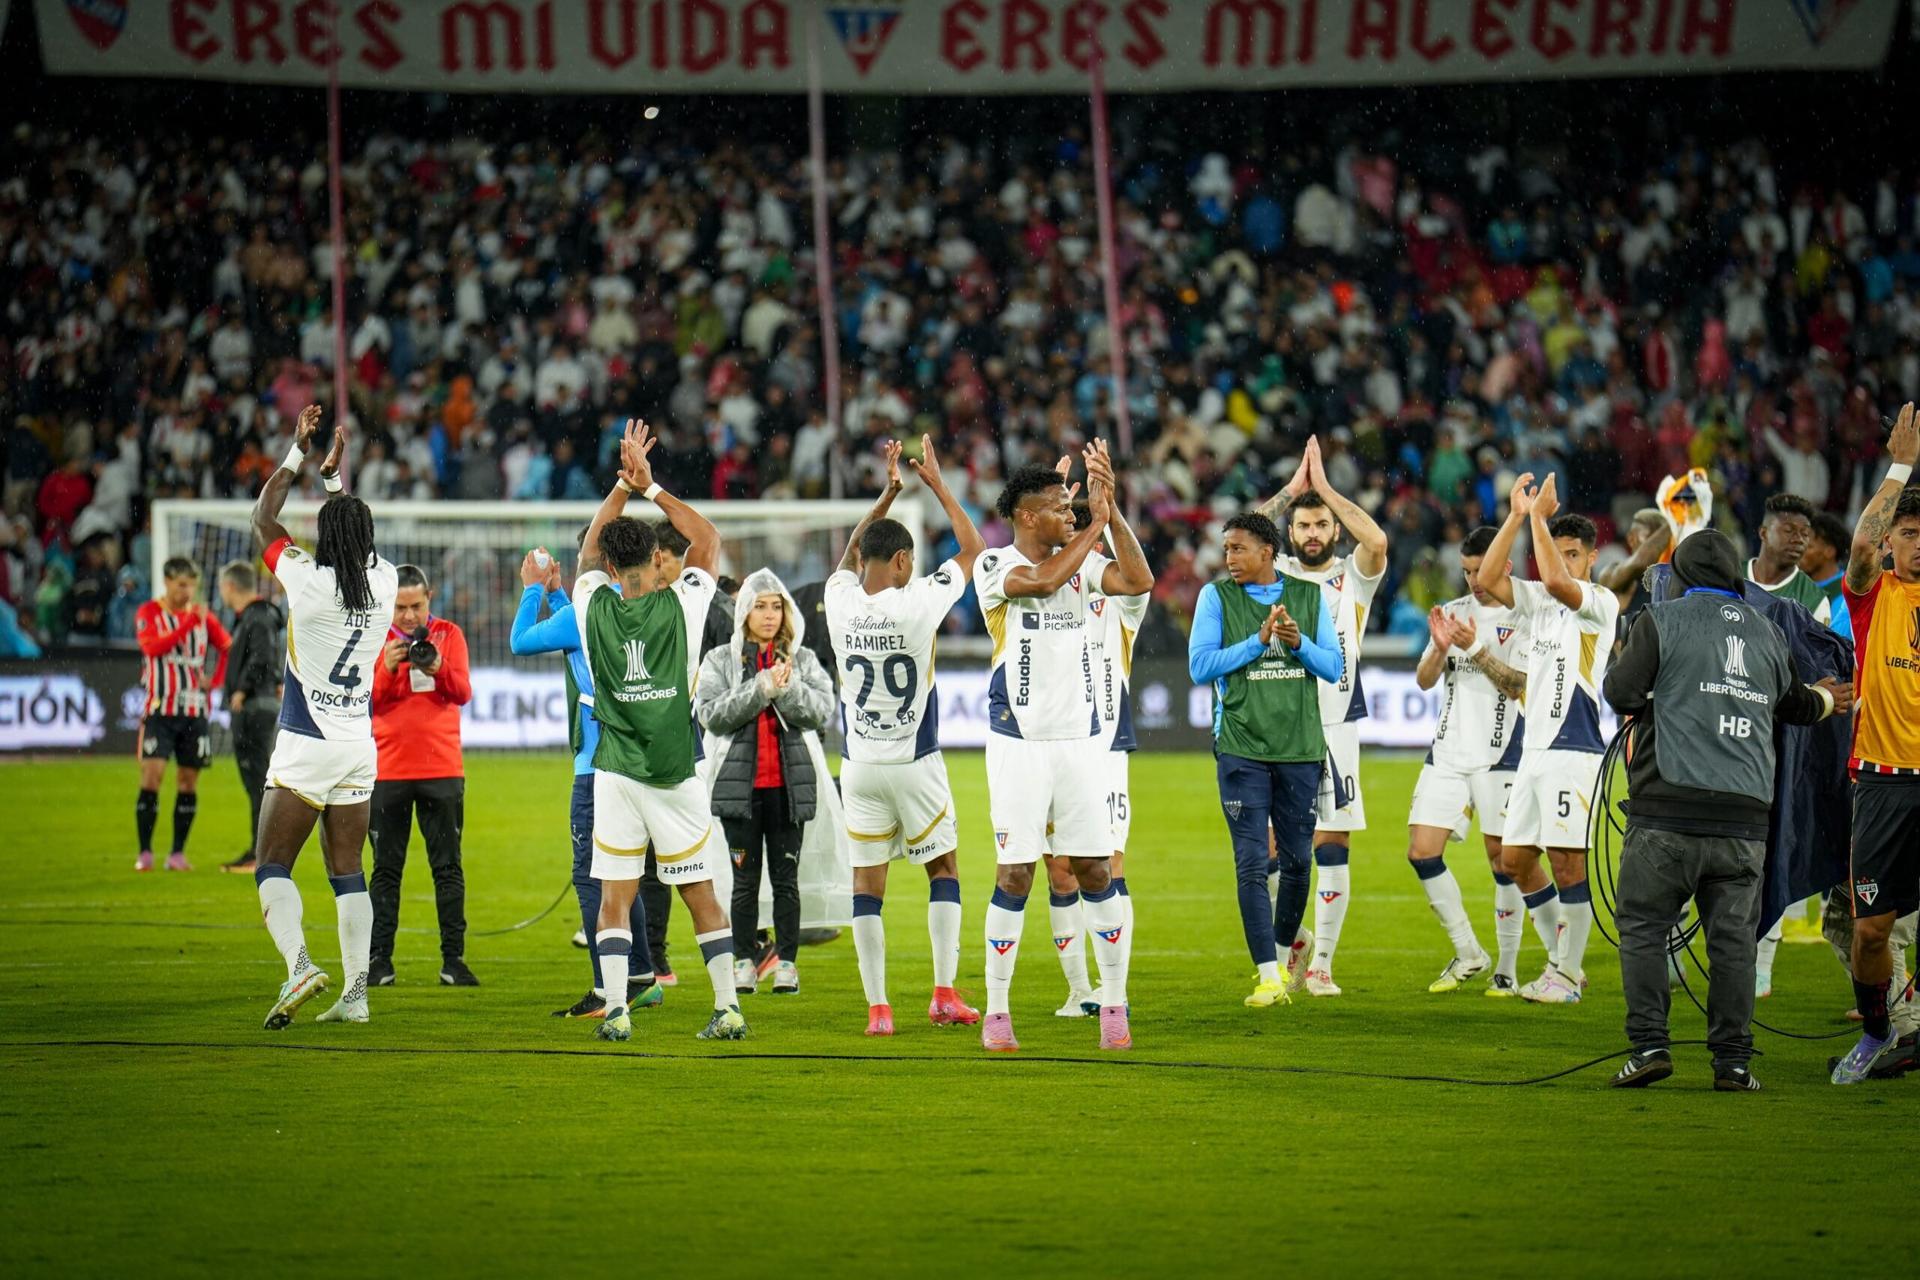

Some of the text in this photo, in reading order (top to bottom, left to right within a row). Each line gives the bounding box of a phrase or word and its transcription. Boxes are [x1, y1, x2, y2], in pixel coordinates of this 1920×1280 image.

[170, 0, 404, 71] ERES
[441, 0, 555, 72] MI
[940, 0, 1735, 71] ERES MI ALEGRIA
[344, 613, 372, 629] ADE
[848, 615, 897, 633] Splendor
[1043, 611, 1074, 621] BANCO
[1724, 610, 1740, 622] 09
[845, 634, 907, 651] RAMIREZ
[1016, 637, 1031, 706] Ecuabet
[845, 653, 918, 721] 29
[1103, 657, 1114, 721] Ecuabet
[1550, 657, 1566, 719] Ecuabet
[1700, 682, 1769, 705] LIBERTADORES
[1490, 688, 1507, 748] Ecuabe
[1719, 714, 1752, 738] HB
[1557, 790, 1571, 818] 5
